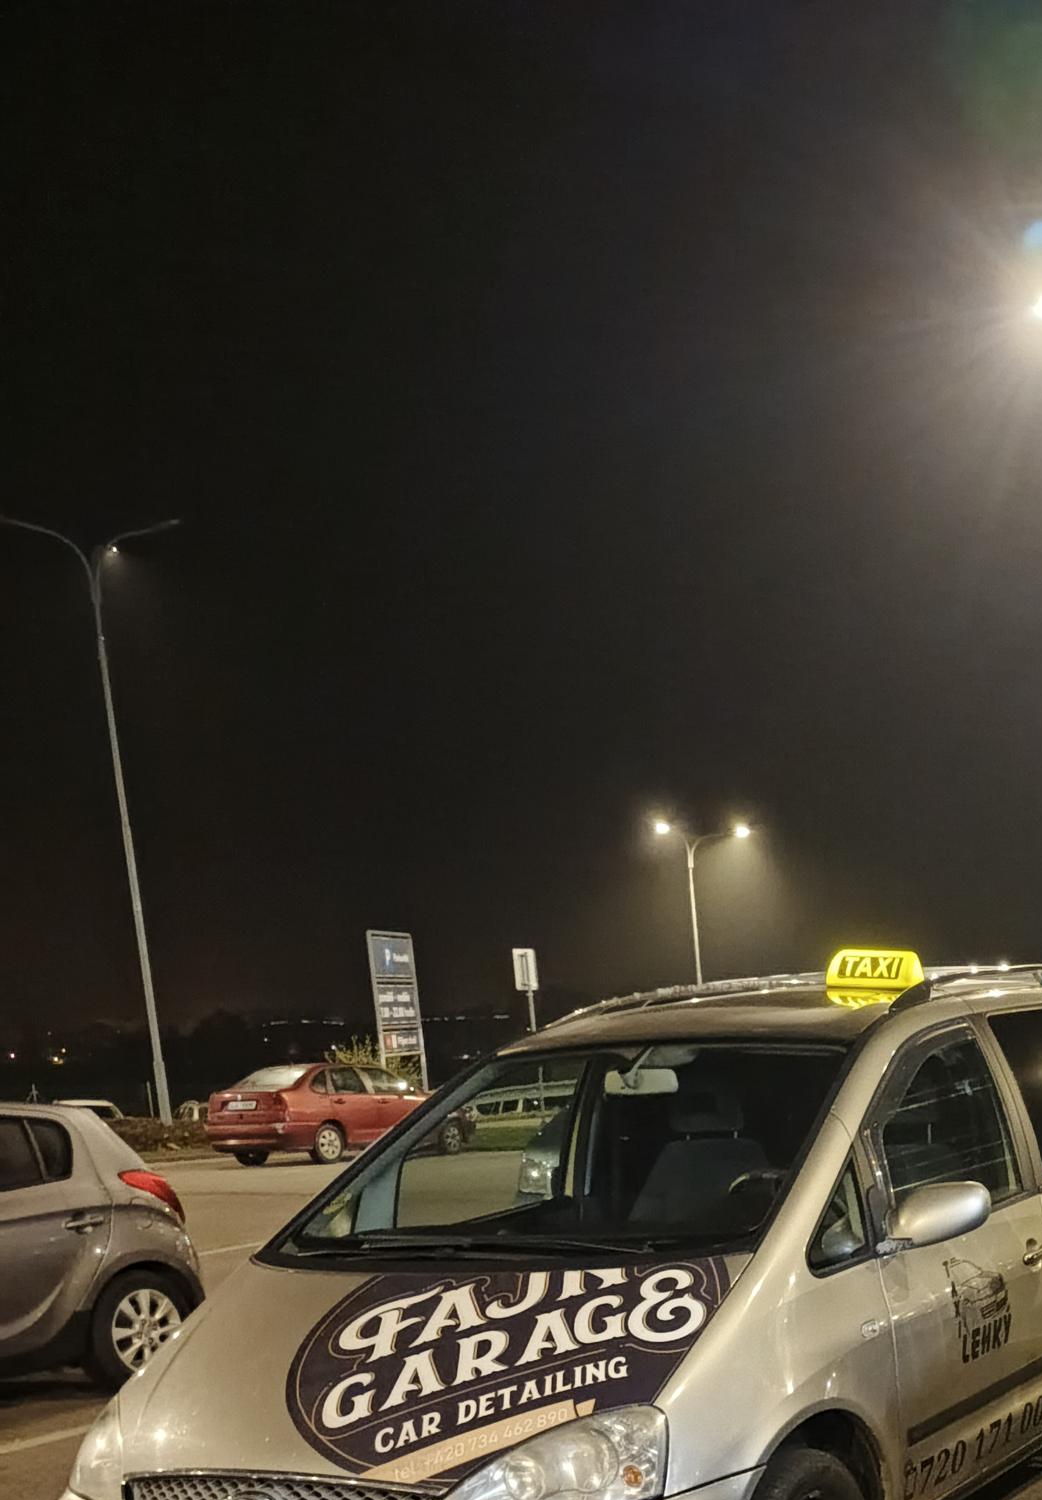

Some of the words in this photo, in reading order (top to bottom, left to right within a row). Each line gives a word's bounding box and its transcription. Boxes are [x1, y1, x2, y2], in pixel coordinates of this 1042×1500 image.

[844, 955, 901, 979] TAXI
[320, 1268, 707, 1430] GARAGE
[373, 1411, 442, 1454] CAR
[456, 1356, 629, 1427] DETAILING
[468, 1431, 499, 1451] 734
[503, 1418, 534, 1440] 462
[536, 1407, 569, 1429] 890
[974, 1412, 1014, 1462] 171
